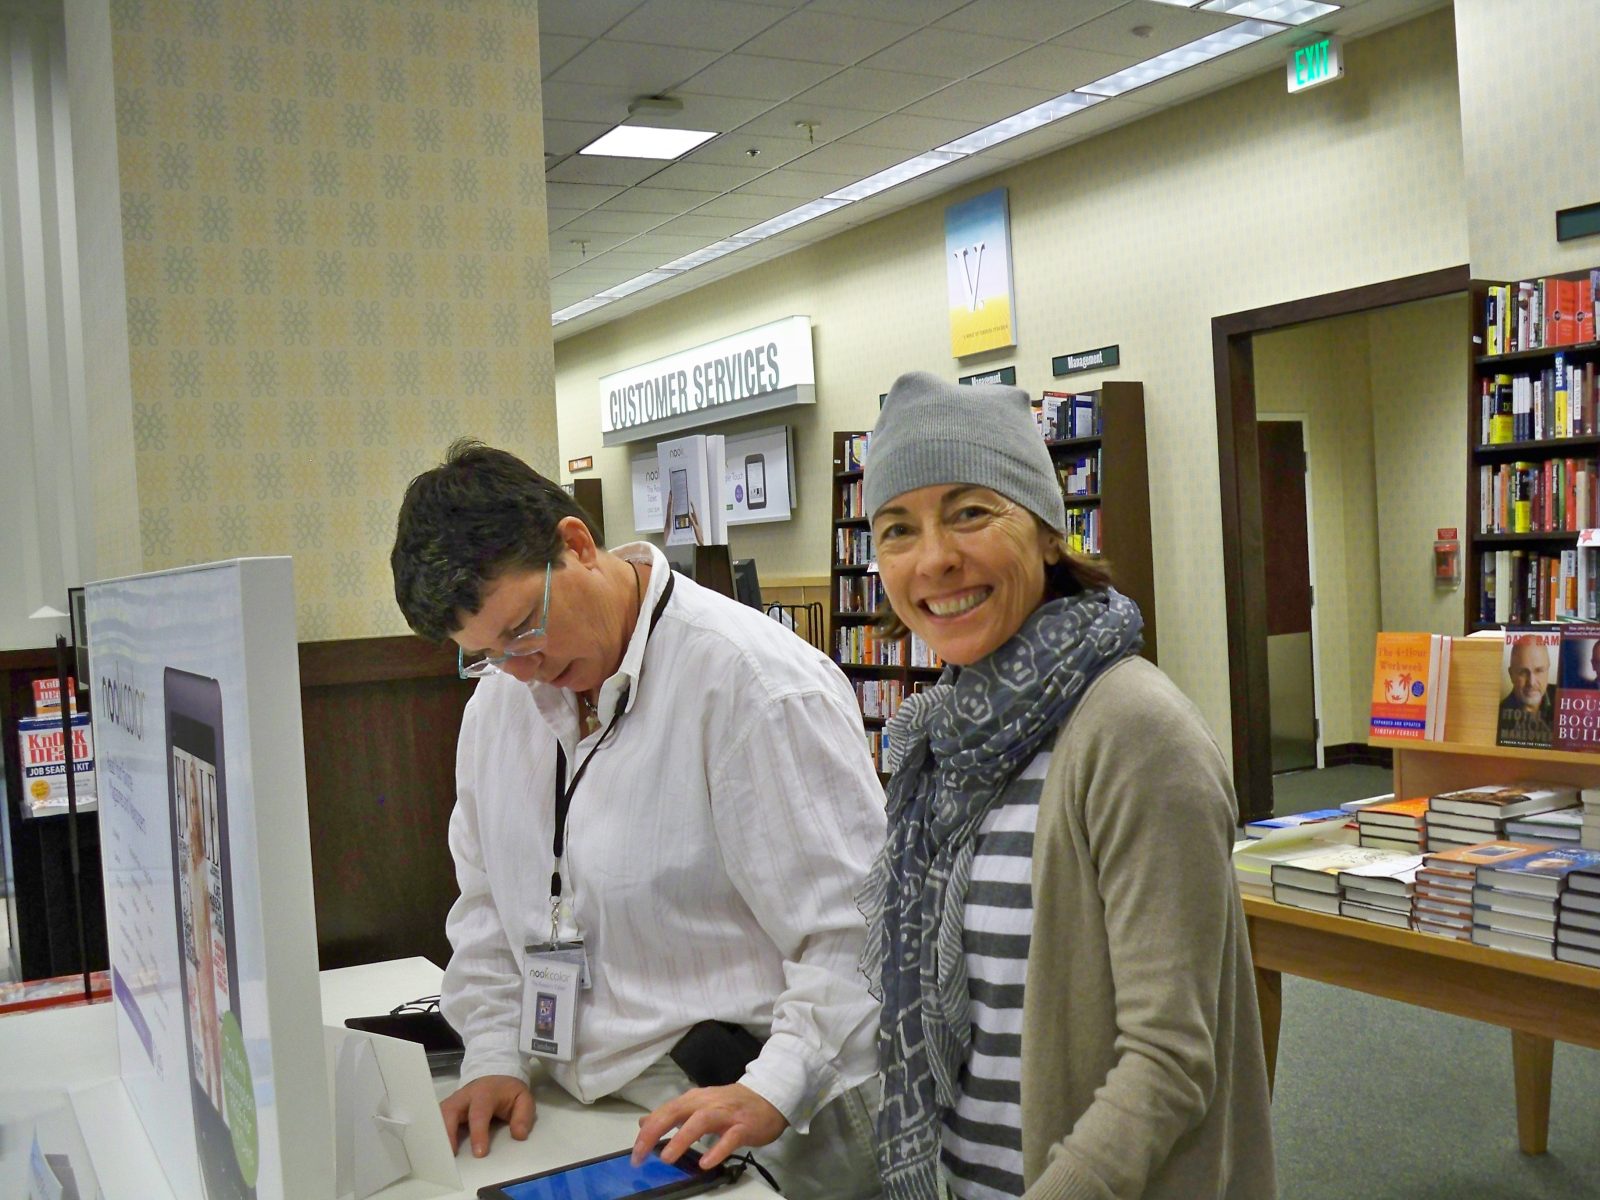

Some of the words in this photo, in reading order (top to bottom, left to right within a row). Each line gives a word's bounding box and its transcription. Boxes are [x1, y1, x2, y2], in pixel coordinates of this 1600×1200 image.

[1295, 39, 1329, 85] EXIT
[1067, 351, 1103, 369] Management
[1555, 357, 1563, 388] SPHR
[609, 369, 688, 430] CUSTOMER
[693, 342, 780, 408] SERVICES
[30, 766, 44, 777] JOB
[77, 762, 90, 771] KIT
